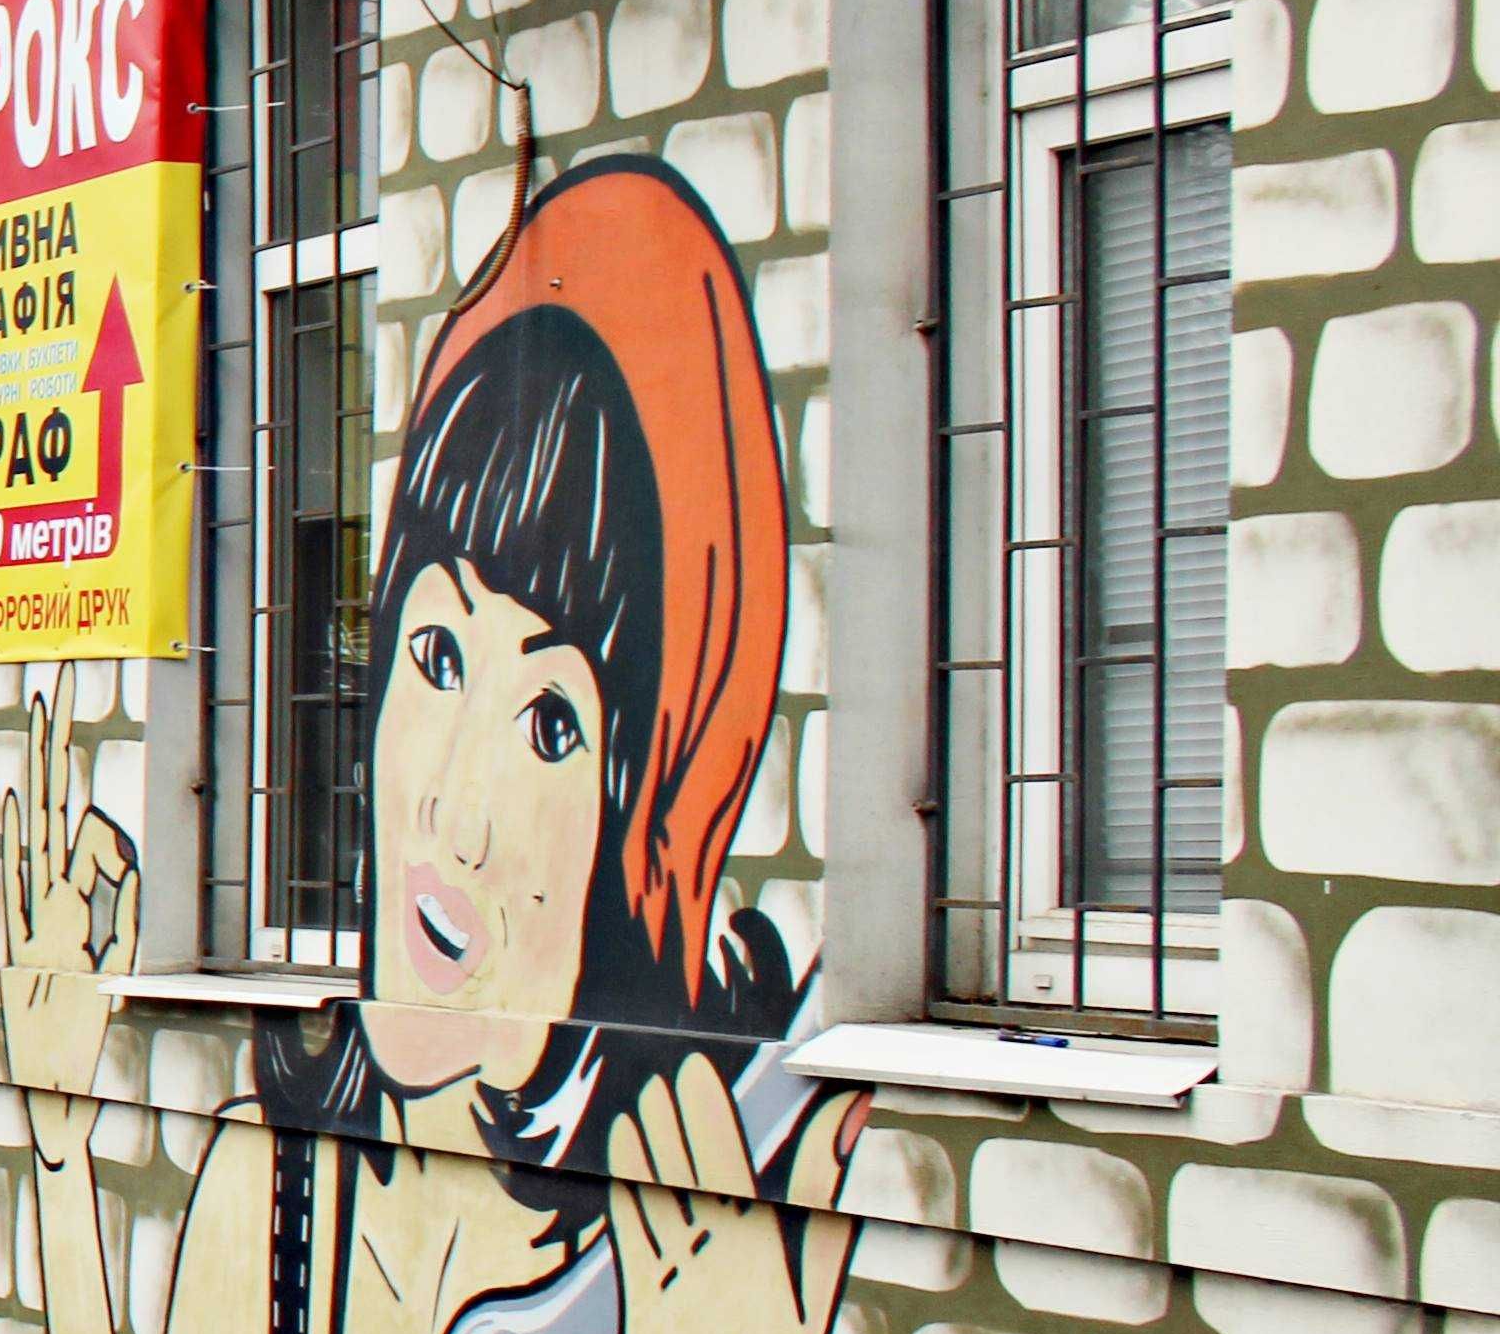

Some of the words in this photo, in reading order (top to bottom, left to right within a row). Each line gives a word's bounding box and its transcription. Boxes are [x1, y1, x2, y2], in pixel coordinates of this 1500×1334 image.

[28, 373, 78, 399] РОБОТИ
[10, 502, 113, 569] метрів
[77, 587, 131, 635] ДРУК
